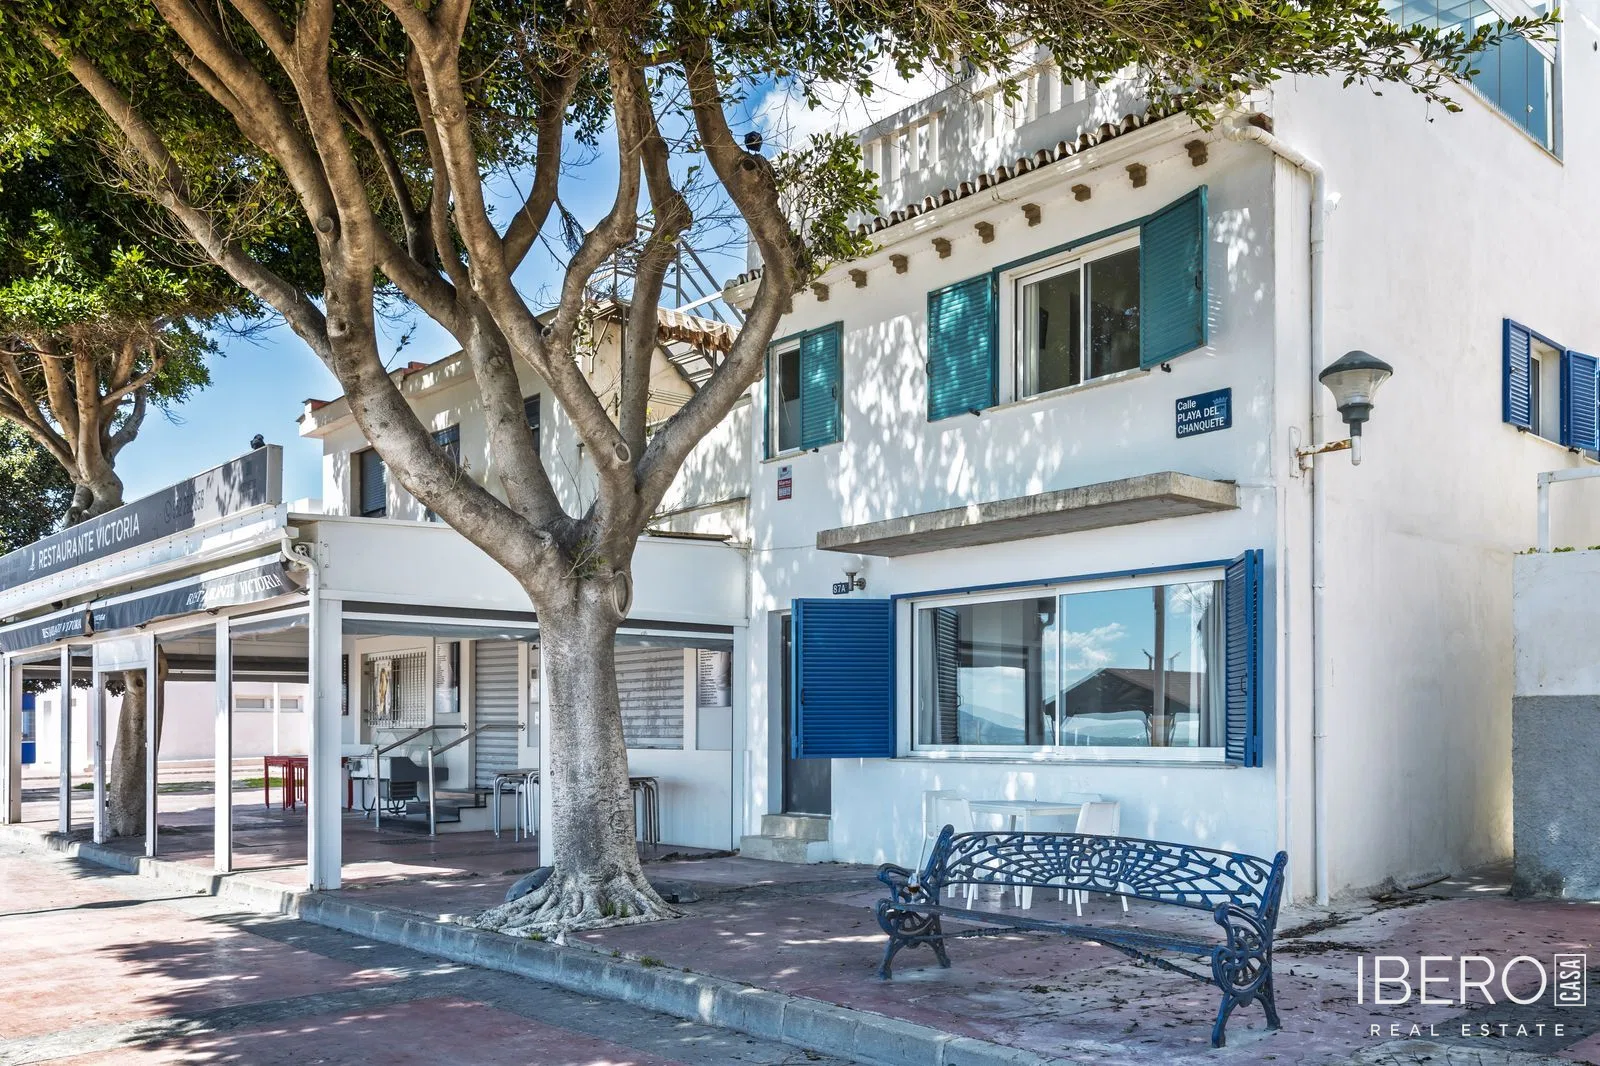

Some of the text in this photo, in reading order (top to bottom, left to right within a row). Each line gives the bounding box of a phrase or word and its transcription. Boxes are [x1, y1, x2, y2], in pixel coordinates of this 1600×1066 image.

[1177, 400, 1196, 411] Calle
[1177, 406, 1219, 422] PLAYA DEL
[1177, 417, 1224, 434] CHANQUETE
[38, 512, 140, 569] RESTAURANTE VICTORIA
[239, 573, 283, 595] VICTORIA
